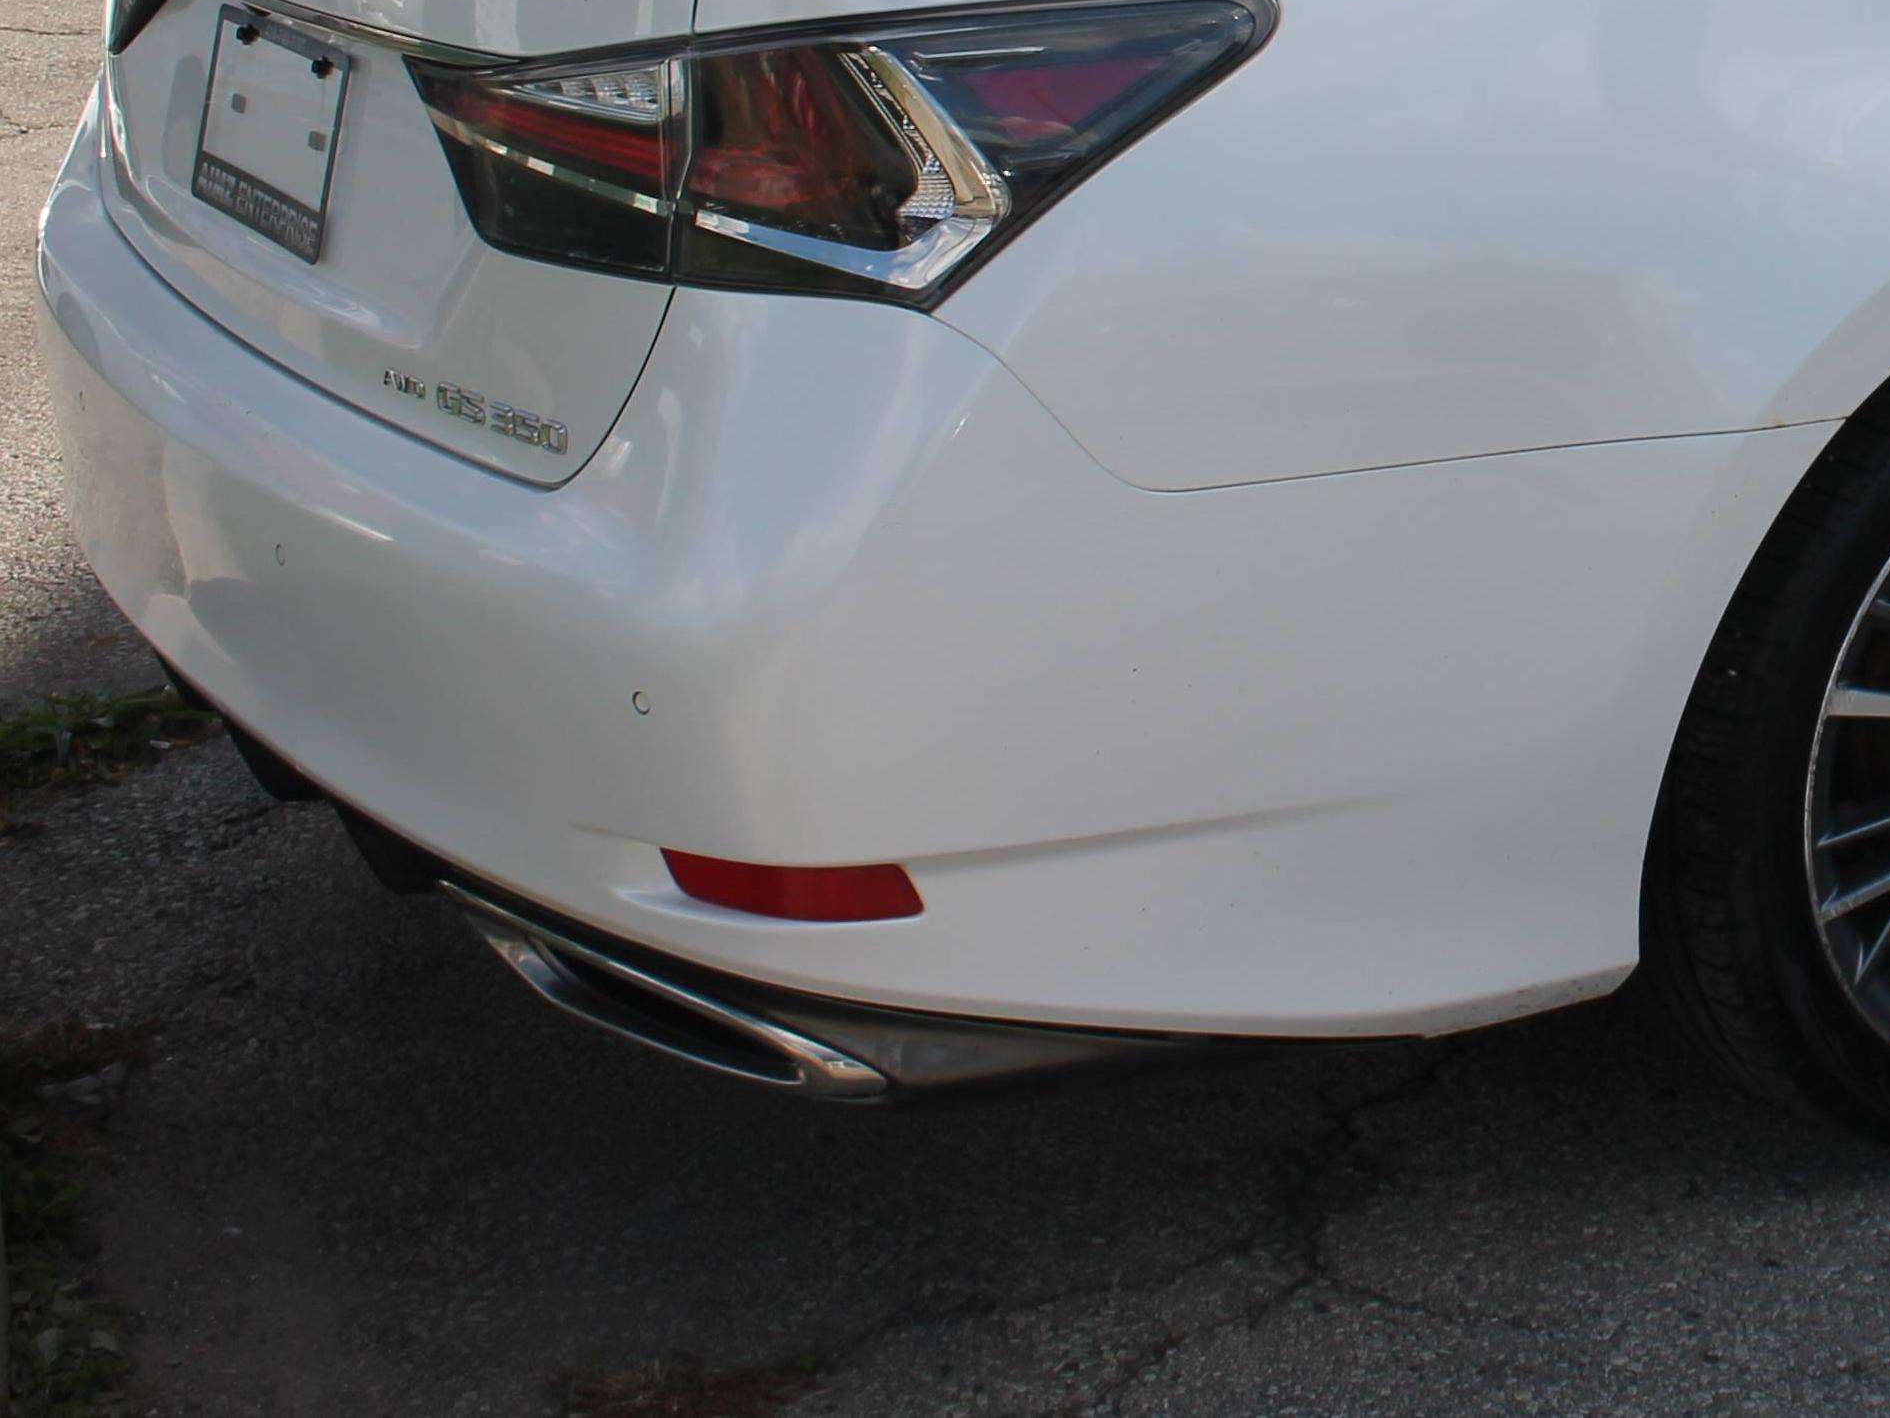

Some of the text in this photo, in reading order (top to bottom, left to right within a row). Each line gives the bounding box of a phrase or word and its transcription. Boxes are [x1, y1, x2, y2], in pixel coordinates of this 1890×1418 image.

[236, 180, 319, 258] ENTERPRISE
[436, 381, 487, 426] GS
[489, 400, 569, 455] 350
